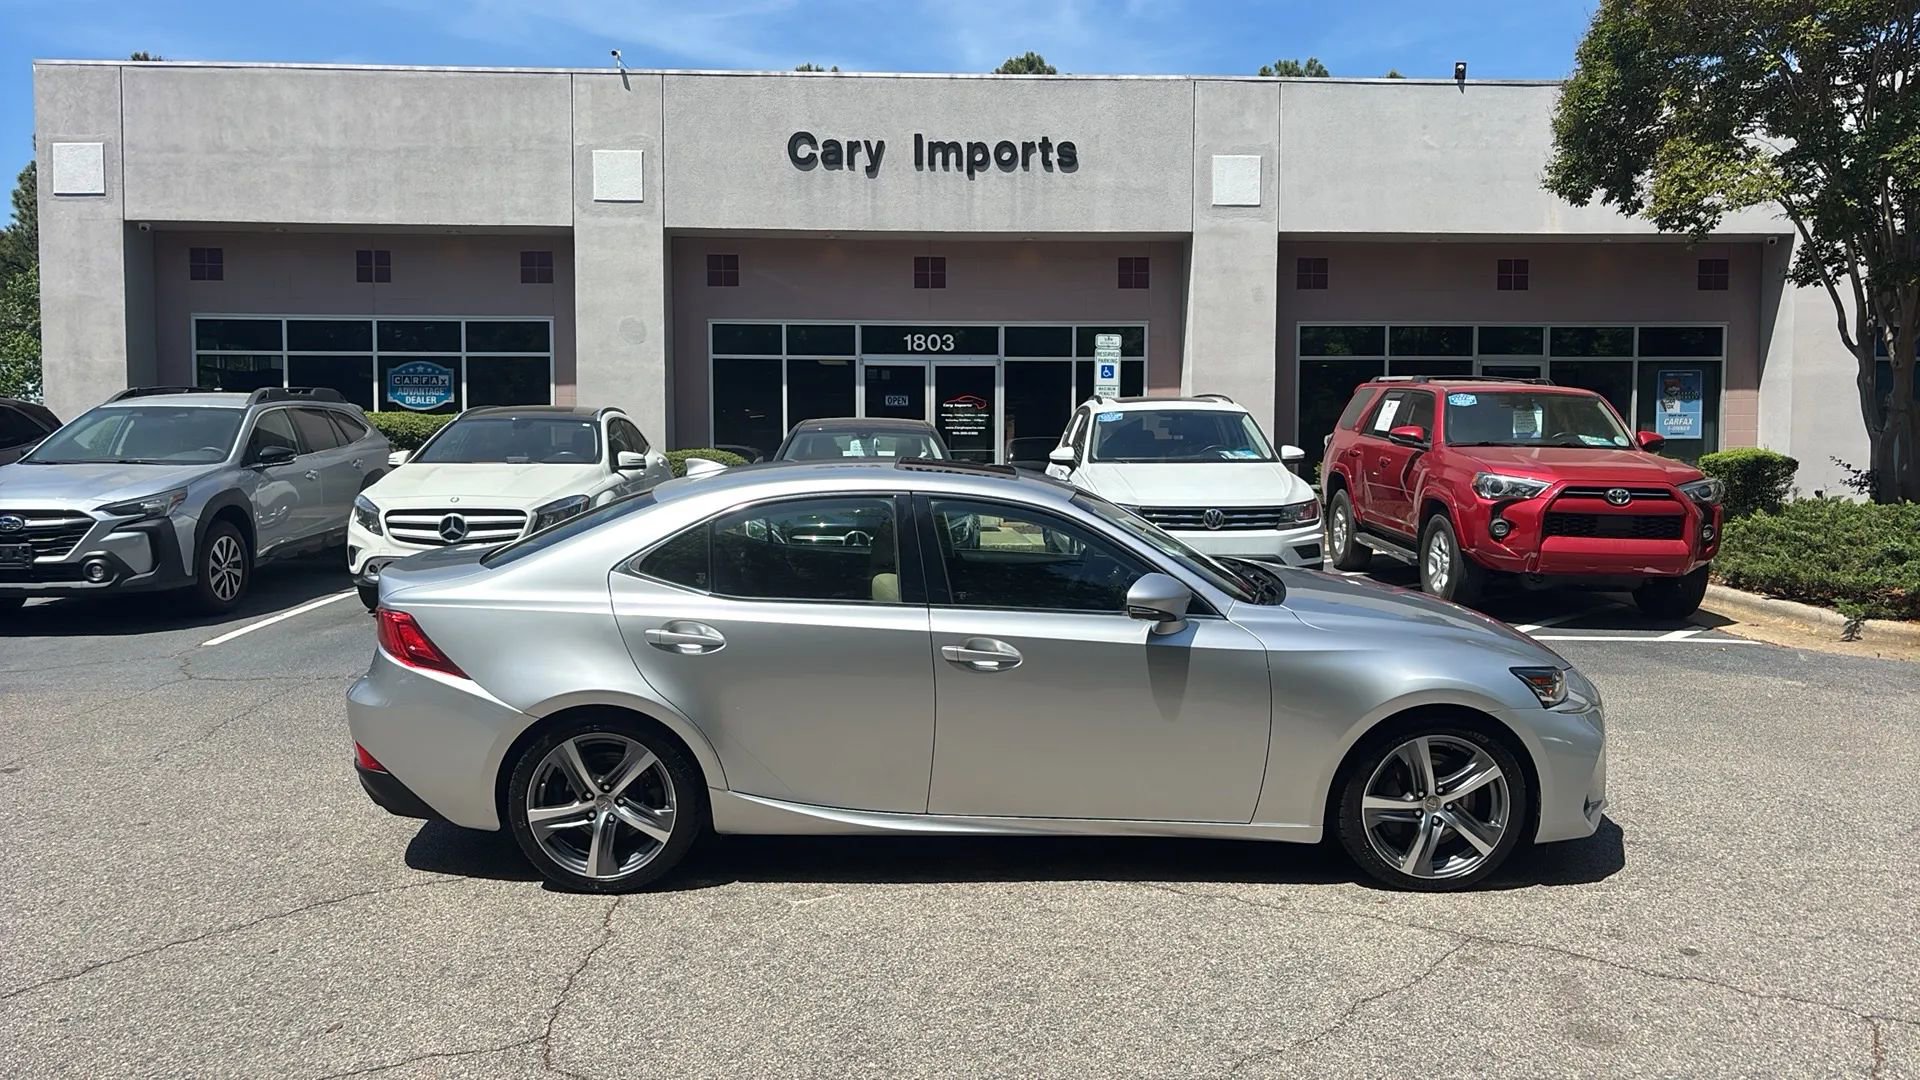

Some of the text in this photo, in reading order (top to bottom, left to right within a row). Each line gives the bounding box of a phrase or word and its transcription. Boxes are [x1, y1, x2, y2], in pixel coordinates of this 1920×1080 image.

[788, 131, 1079, 181] Cary Imports
[903, 333, 955, 352] 1803
[393, 376, 448, 386] CARFAX
[397, 387, 445, 396] ADVANTAGE
[405, 396, 437, 404] DEALER
[886, 396, 908, 405] OPEN
[1663, 418, 1694, 426] CARFAX
